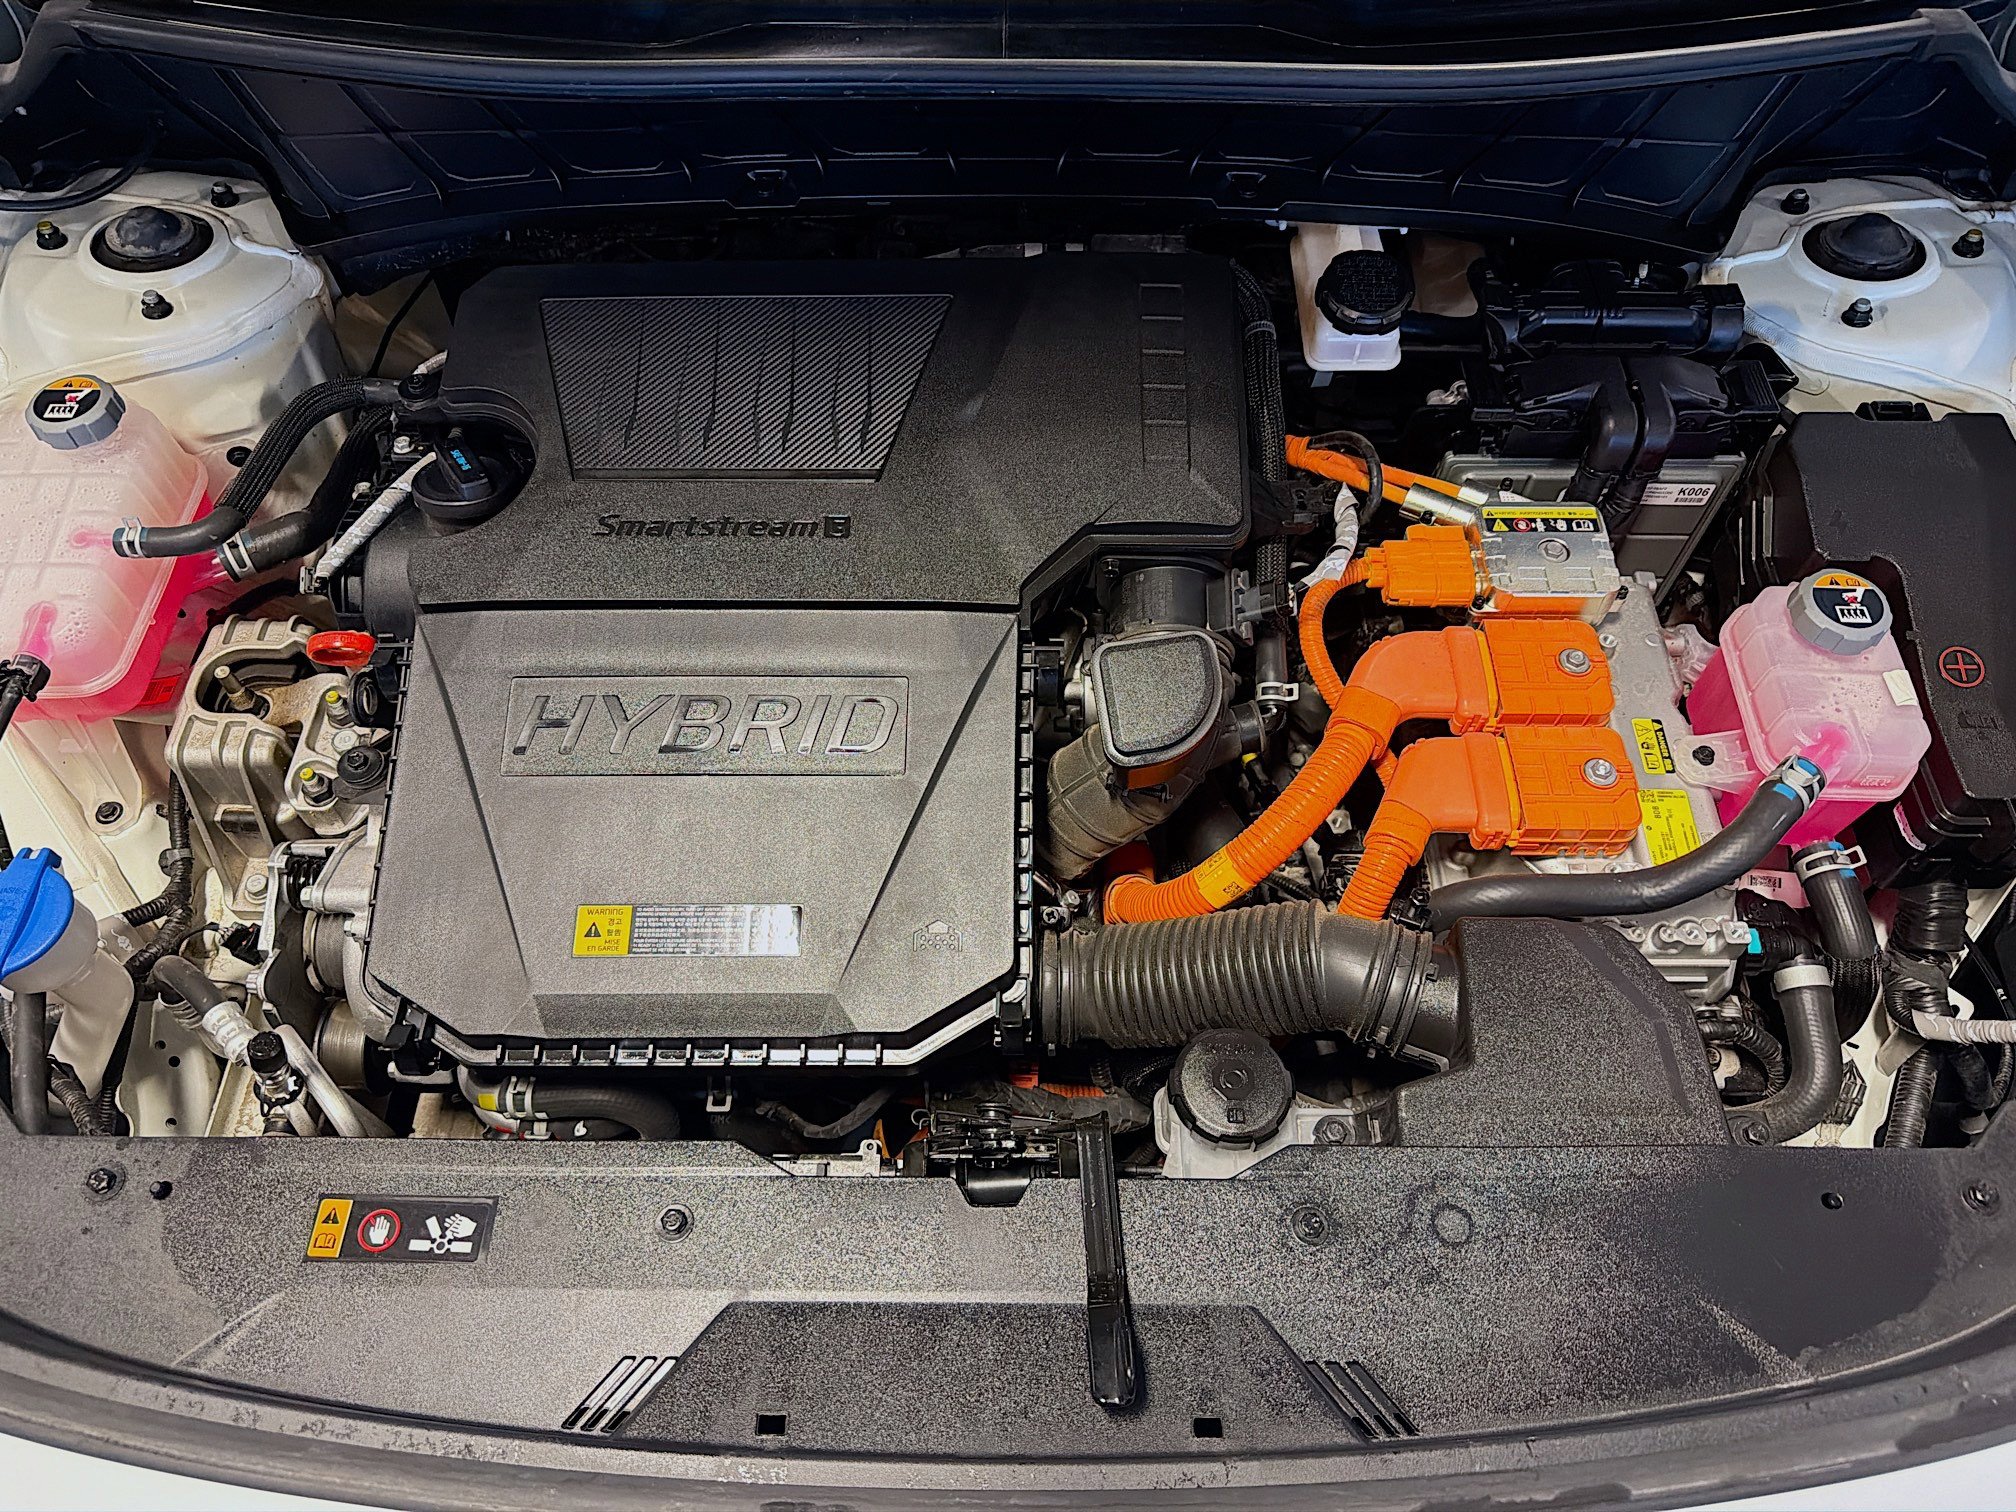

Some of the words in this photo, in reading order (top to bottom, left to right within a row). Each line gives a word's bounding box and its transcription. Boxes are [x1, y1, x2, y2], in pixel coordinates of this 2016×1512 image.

[1677, 487, 1711, 497] K006
[592, 514, 819, 538] Smartstream
[512, 693, 899, 755] HYBRID
[1655, 731, 1669, 758] DANGER
[587, 908, 624, 916] WARNING
[608, 917, 623, 926] 경고
